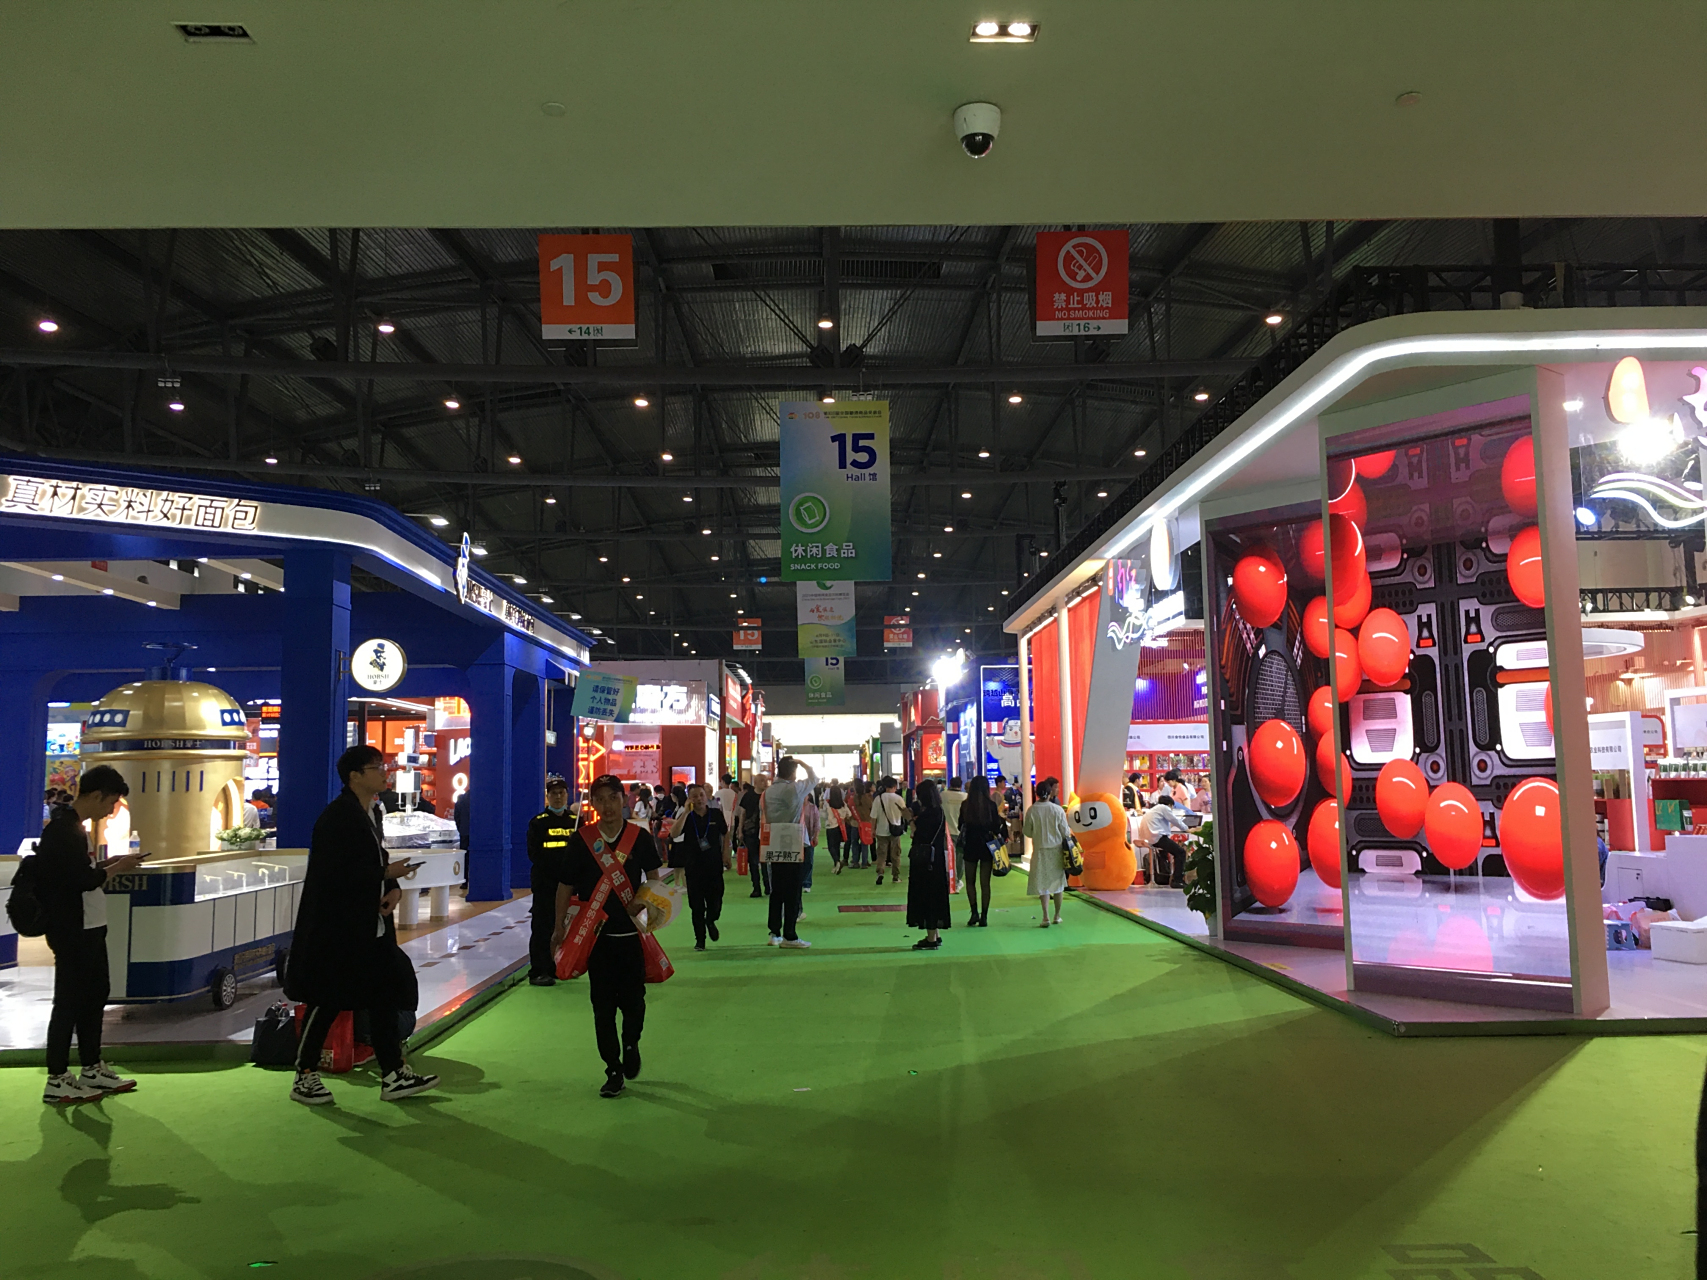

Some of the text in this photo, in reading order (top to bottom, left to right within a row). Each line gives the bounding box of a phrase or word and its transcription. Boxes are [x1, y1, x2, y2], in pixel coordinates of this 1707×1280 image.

[549, 253, 623, 306] 15
[1053, 291, 1112, 309] 禁止吸烟
[1055, 309, 1109, 318] NO SMOKING
[577, 326, 591, 336] 14
[1075, 322, 1090, 333] 16
[830, 432, 877, 470] 15
[846, 472, 878, 482] Hall 馆
[3, 478, 259, 531] 真材实料好面包
[790, 542, 856, 558] 休闲食品
[818, 562, 841, 570] FOOD
[738, 623, 759, 640] 15
[592, 684, 621, 697] 请保管好
[590, 695, 617, 707] 个人物品
[587, 705, 616, 718] 谨防丢失
[144, 740, 184, 748] HORSH
[102, 875, 148, 891] RSH
